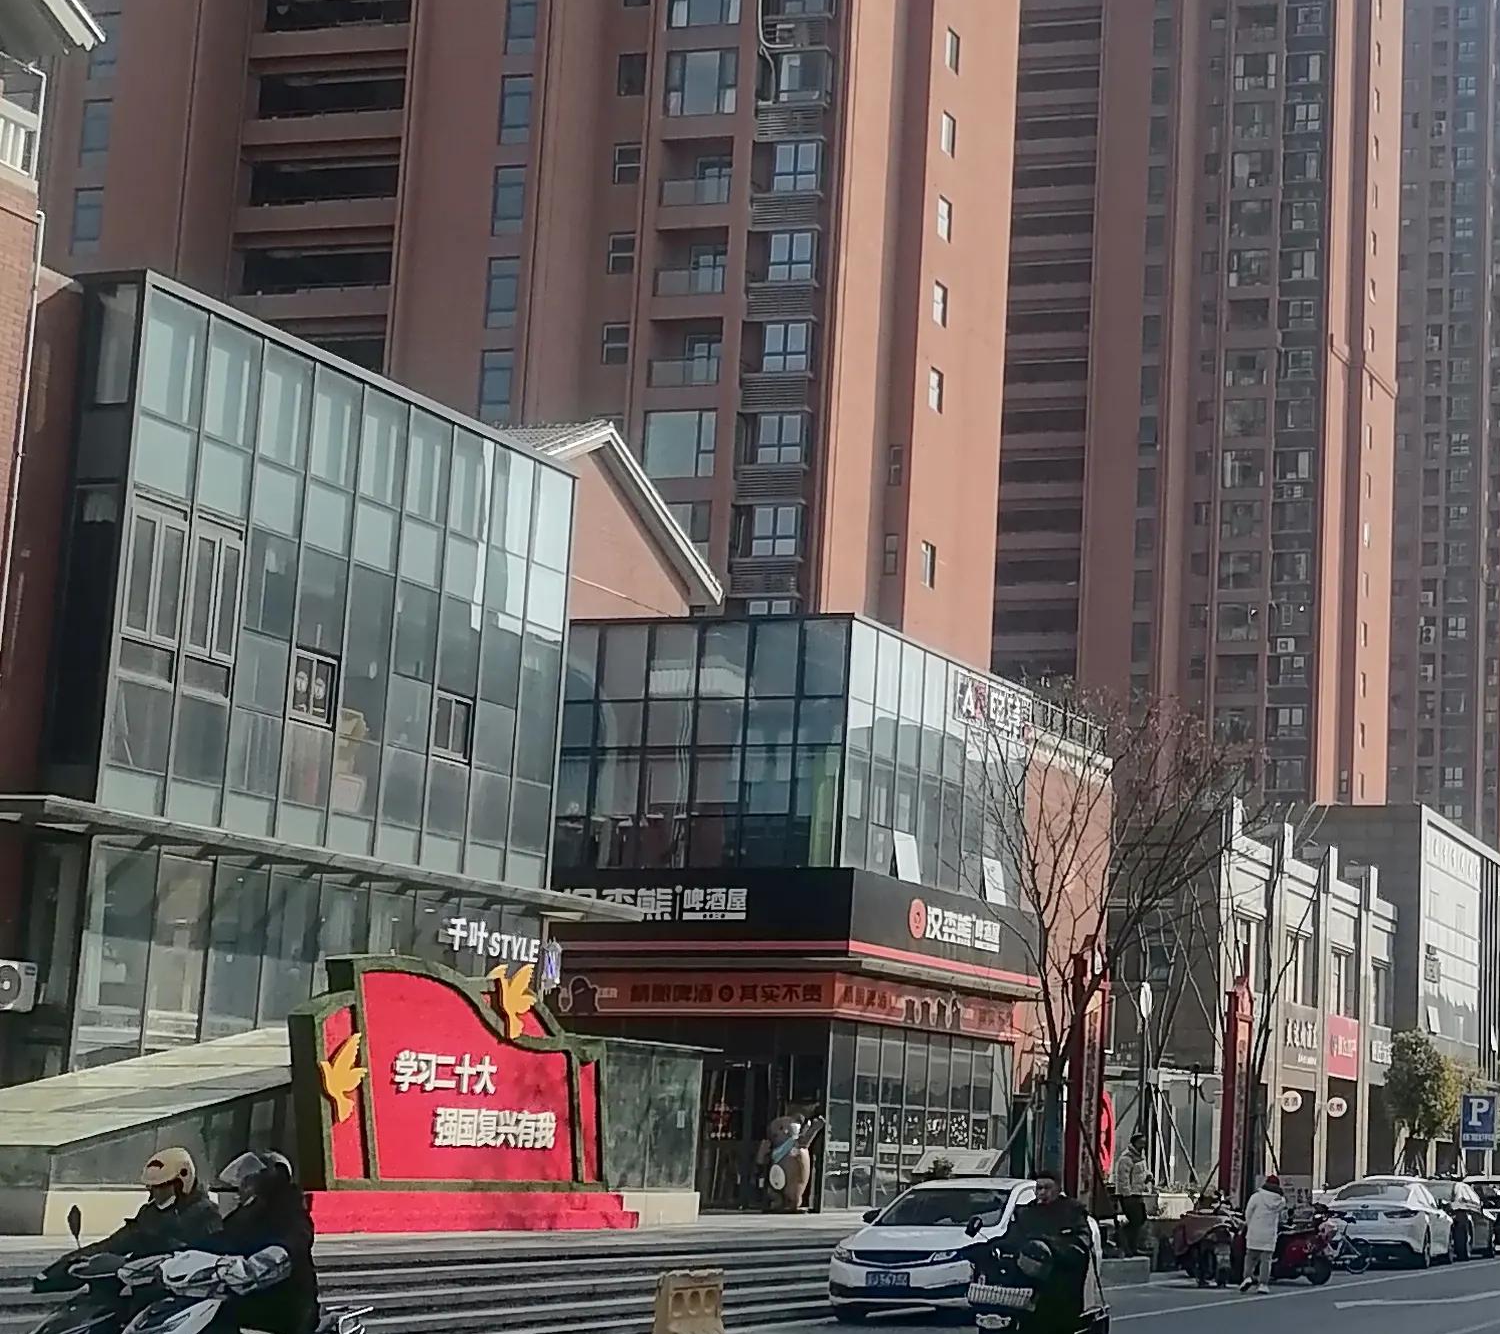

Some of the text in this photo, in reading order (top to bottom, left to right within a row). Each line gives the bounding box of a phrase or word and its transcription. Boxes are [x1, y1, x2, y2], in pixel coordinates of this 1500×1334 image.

[564, 887, 748, 920] 杰熊 啤酒屋
[448, 917, 541, 963] 千叶 STYLE
[394, 1049, 498, 1095] 学习二十大
[433, 1106, 557, 1149] 强国复兴有我
[1468, 1098, 1490, 1127] P
